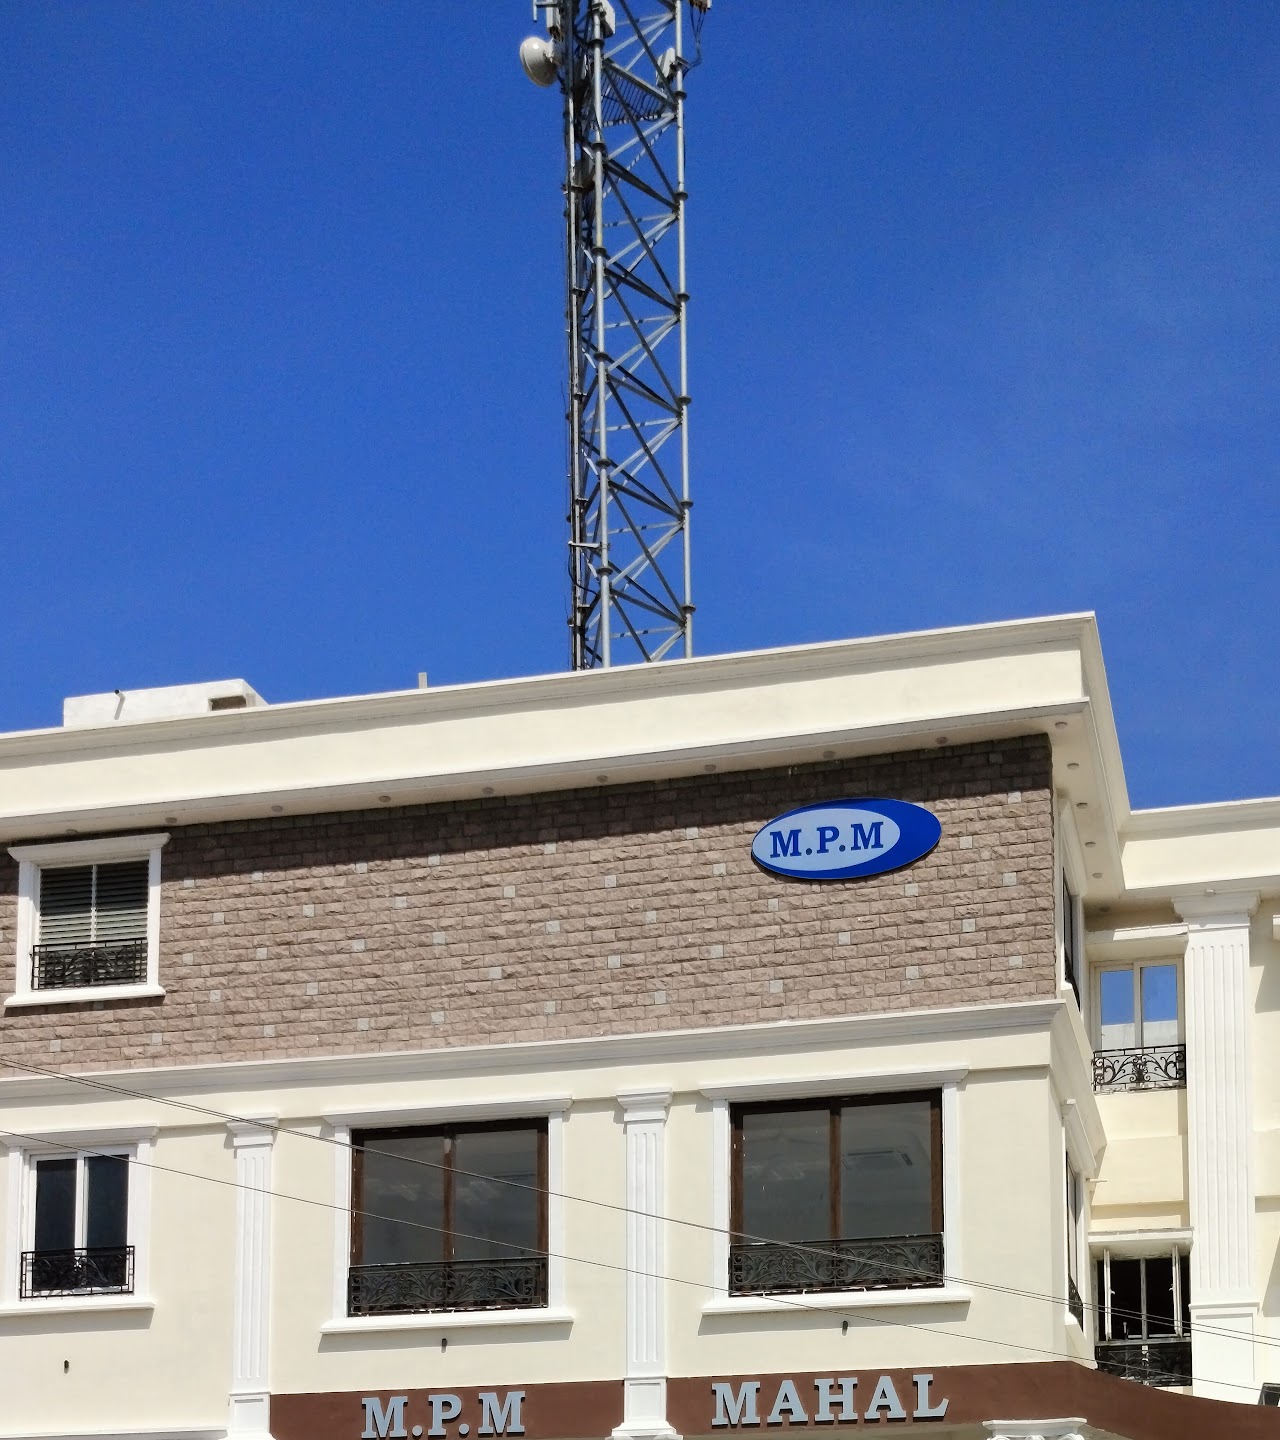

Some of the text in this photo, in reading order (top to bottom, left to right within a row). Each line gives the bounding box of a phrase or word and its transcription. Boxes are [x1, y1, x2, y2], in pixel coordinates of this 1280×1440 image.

[769, 821, 884, 859] M.P.M
[361, 1373, 950, 1439] M.P.M MAHAL
